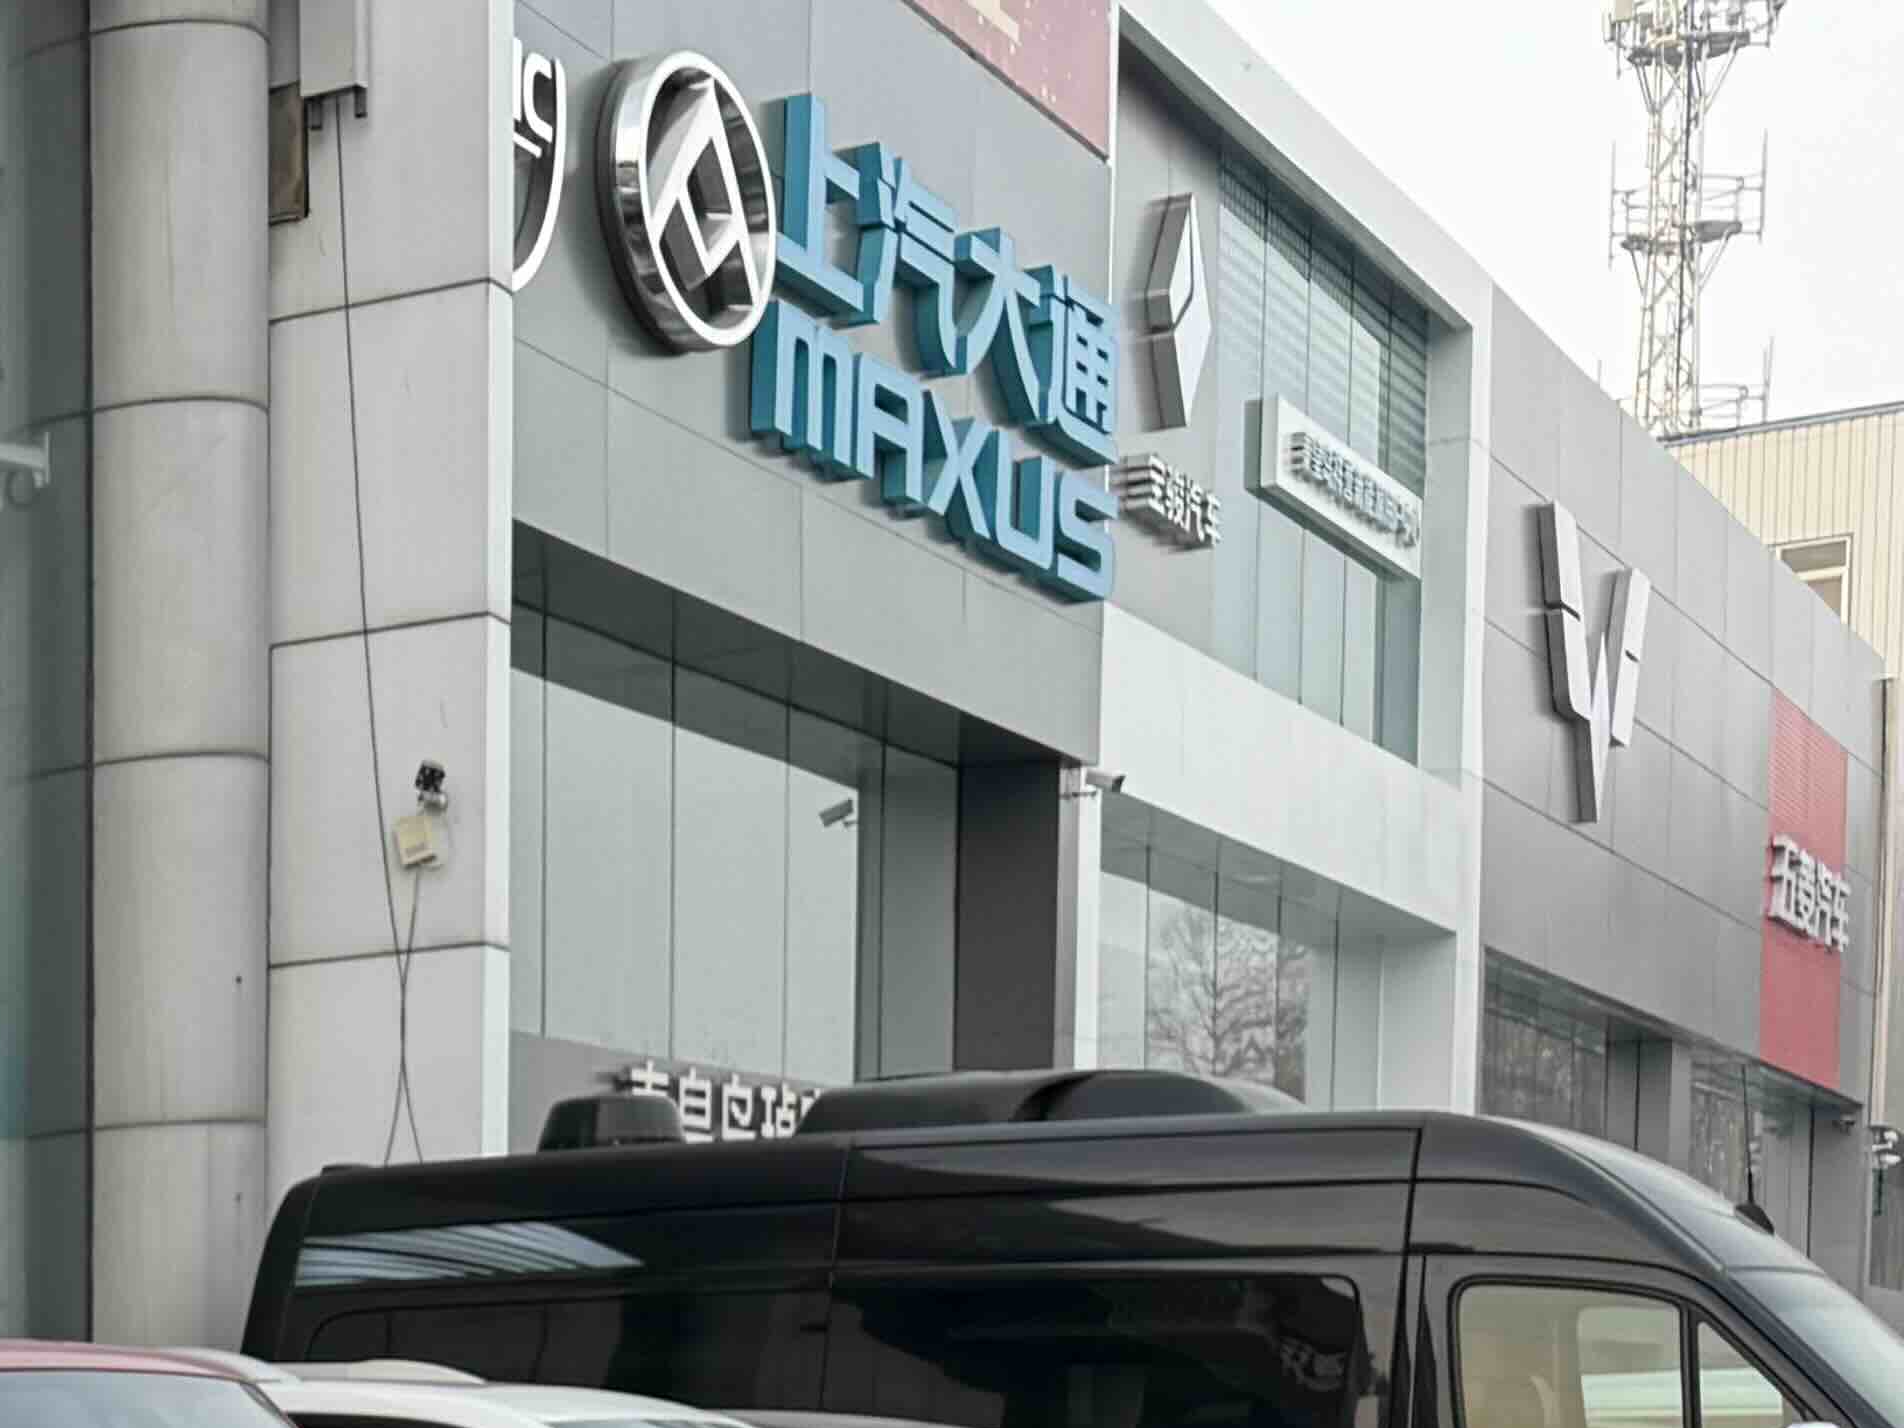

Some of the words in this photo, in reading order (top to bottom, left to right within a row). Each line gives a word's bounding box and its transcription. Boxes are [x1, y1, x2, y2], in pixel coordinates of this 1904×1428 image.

[774, 93, 1122, 466] 上汽大通
[754, 299, 1120, 600] MAXUS
